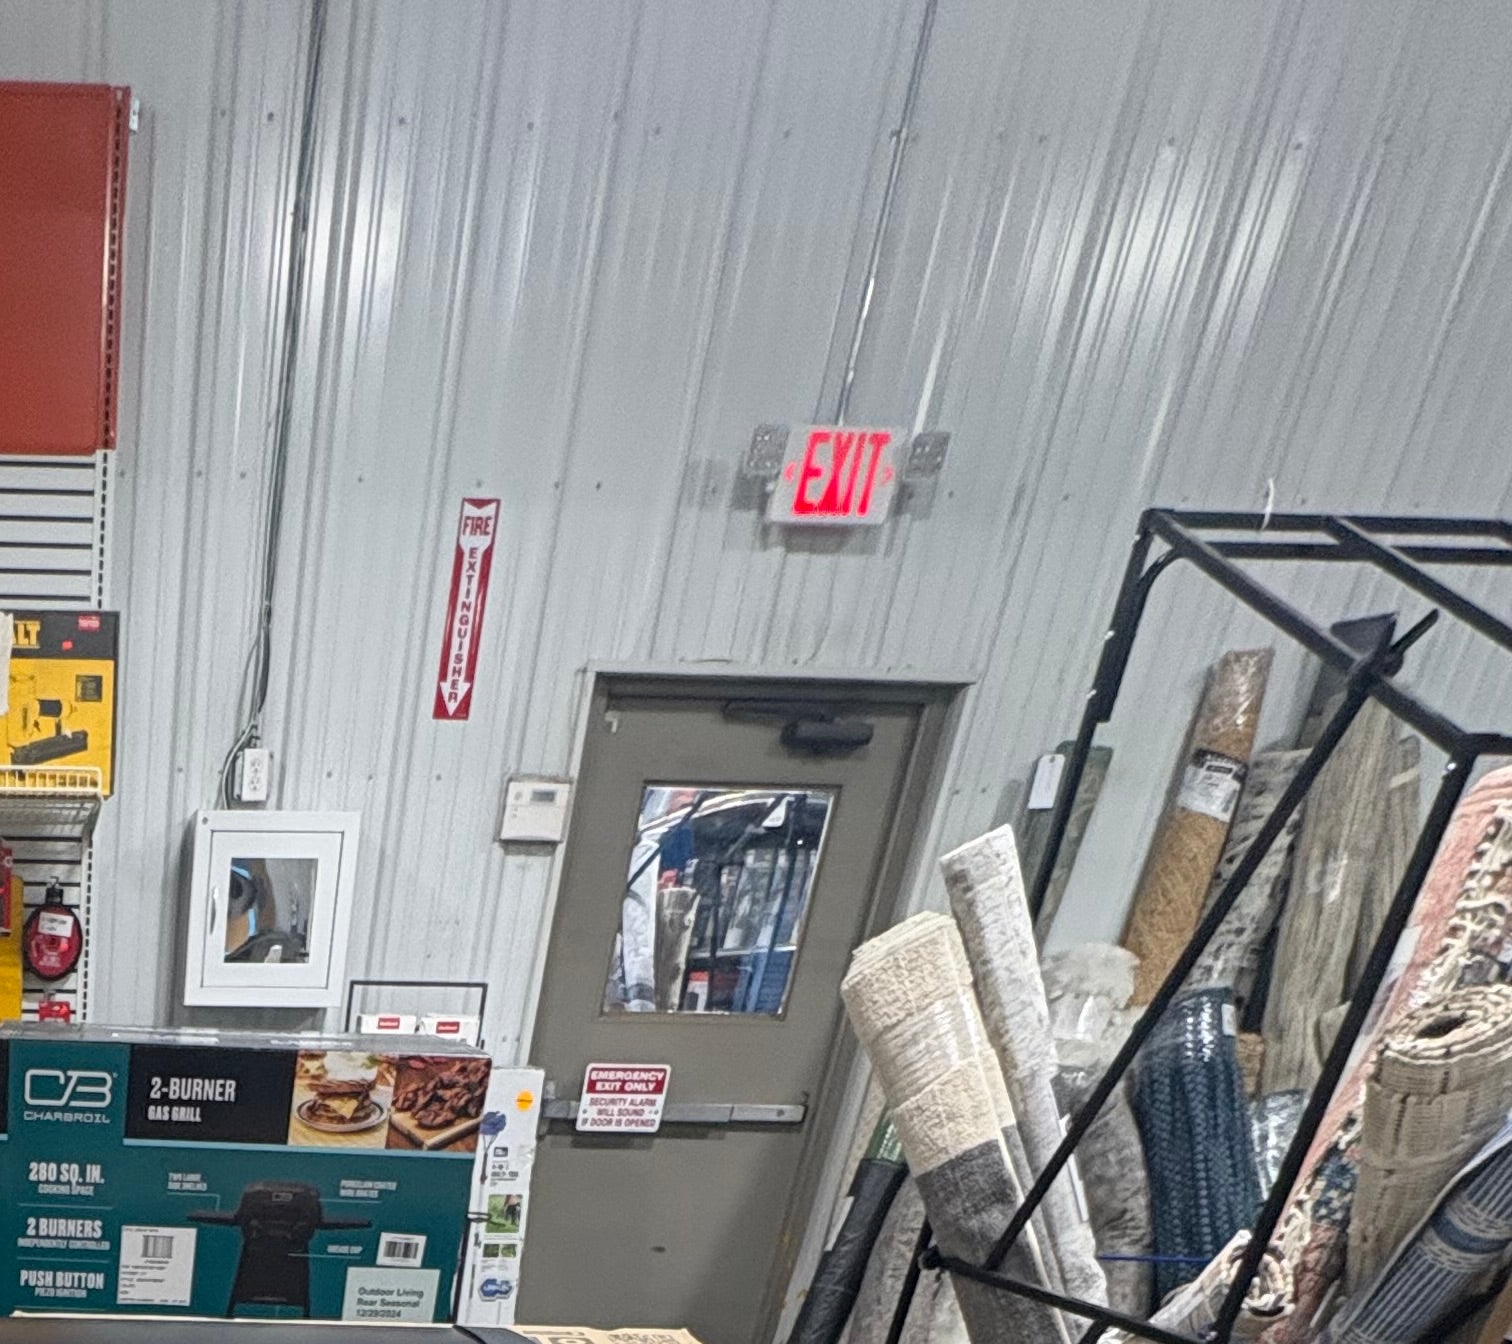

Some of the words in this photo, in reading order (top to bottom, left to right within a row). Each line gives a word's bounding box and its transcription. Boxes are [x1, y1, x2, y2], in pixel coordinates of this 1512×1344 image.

[793, 431, 893, 516] EXIT
[462, 516, 491, 536] FIRE
[448, 547, 478, 703] EXTINGUISHER
[590, 1070, 664, 1080] EMERGENCY
[149, 1077, 236, 1102] 2-BURNER
[595, 1081, 621, 1091] EXIT
[624, 1082, 656, 1091] ONLY
[589, 1098, 627, 1107] SECURITY
[629, 1098, 657, 1106] ALARM
[23, 1111, 110, 1124] CHARBROIL
[147, 1105, 170, 1121] GAS
[171, 1106, 201, 1122] GRILL
[596, 1108, 615, 1117] WILL
[616, 1108, 645, 1117] SOUND
[590, 1118, 613, 1127] DOOR
[624, 1119, 656, 1127] OPENED
[28, 1162, 57, 1182] 280
[59, 1163, 83, 1188] SQ.
[86, 1164, 105, 1184] IN.
[26, 1217, 37, 1236] 2
[39, 1217, 103, 1238] BURNERS
[20, 1270, 53, 1287] PUSH
[55, 1271, 104, 1289] BUTTON
[358, 1287, 394, 1298] Outdoor
[397, 1287, 424, 1299] Living
[357, 1298, 377, 1307] Rear
[380, 1299, 419, 1308] Seasonal
